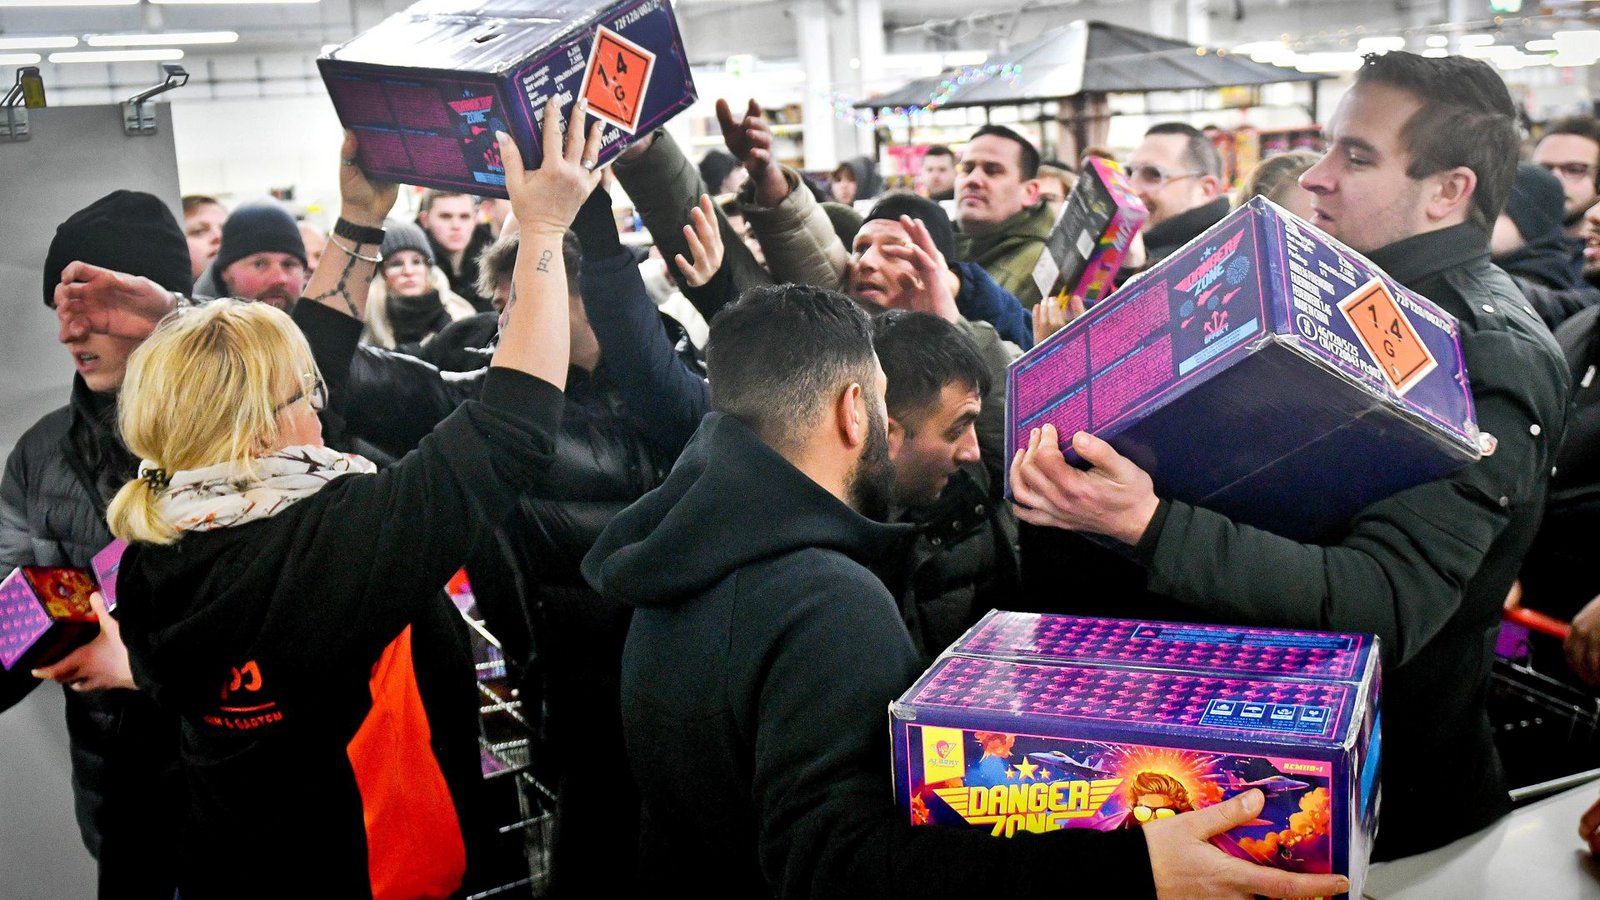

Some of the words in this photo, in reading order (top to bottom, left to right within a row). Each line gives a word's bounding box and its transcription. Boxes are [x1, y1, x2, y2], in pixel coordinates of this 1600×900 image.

[614, 85, 625, 101] G
[1194, 264, 1225, 297] ZONE
[1383, 339, 1396, 359] G
[968, 780, 1090, 816] DANGER
